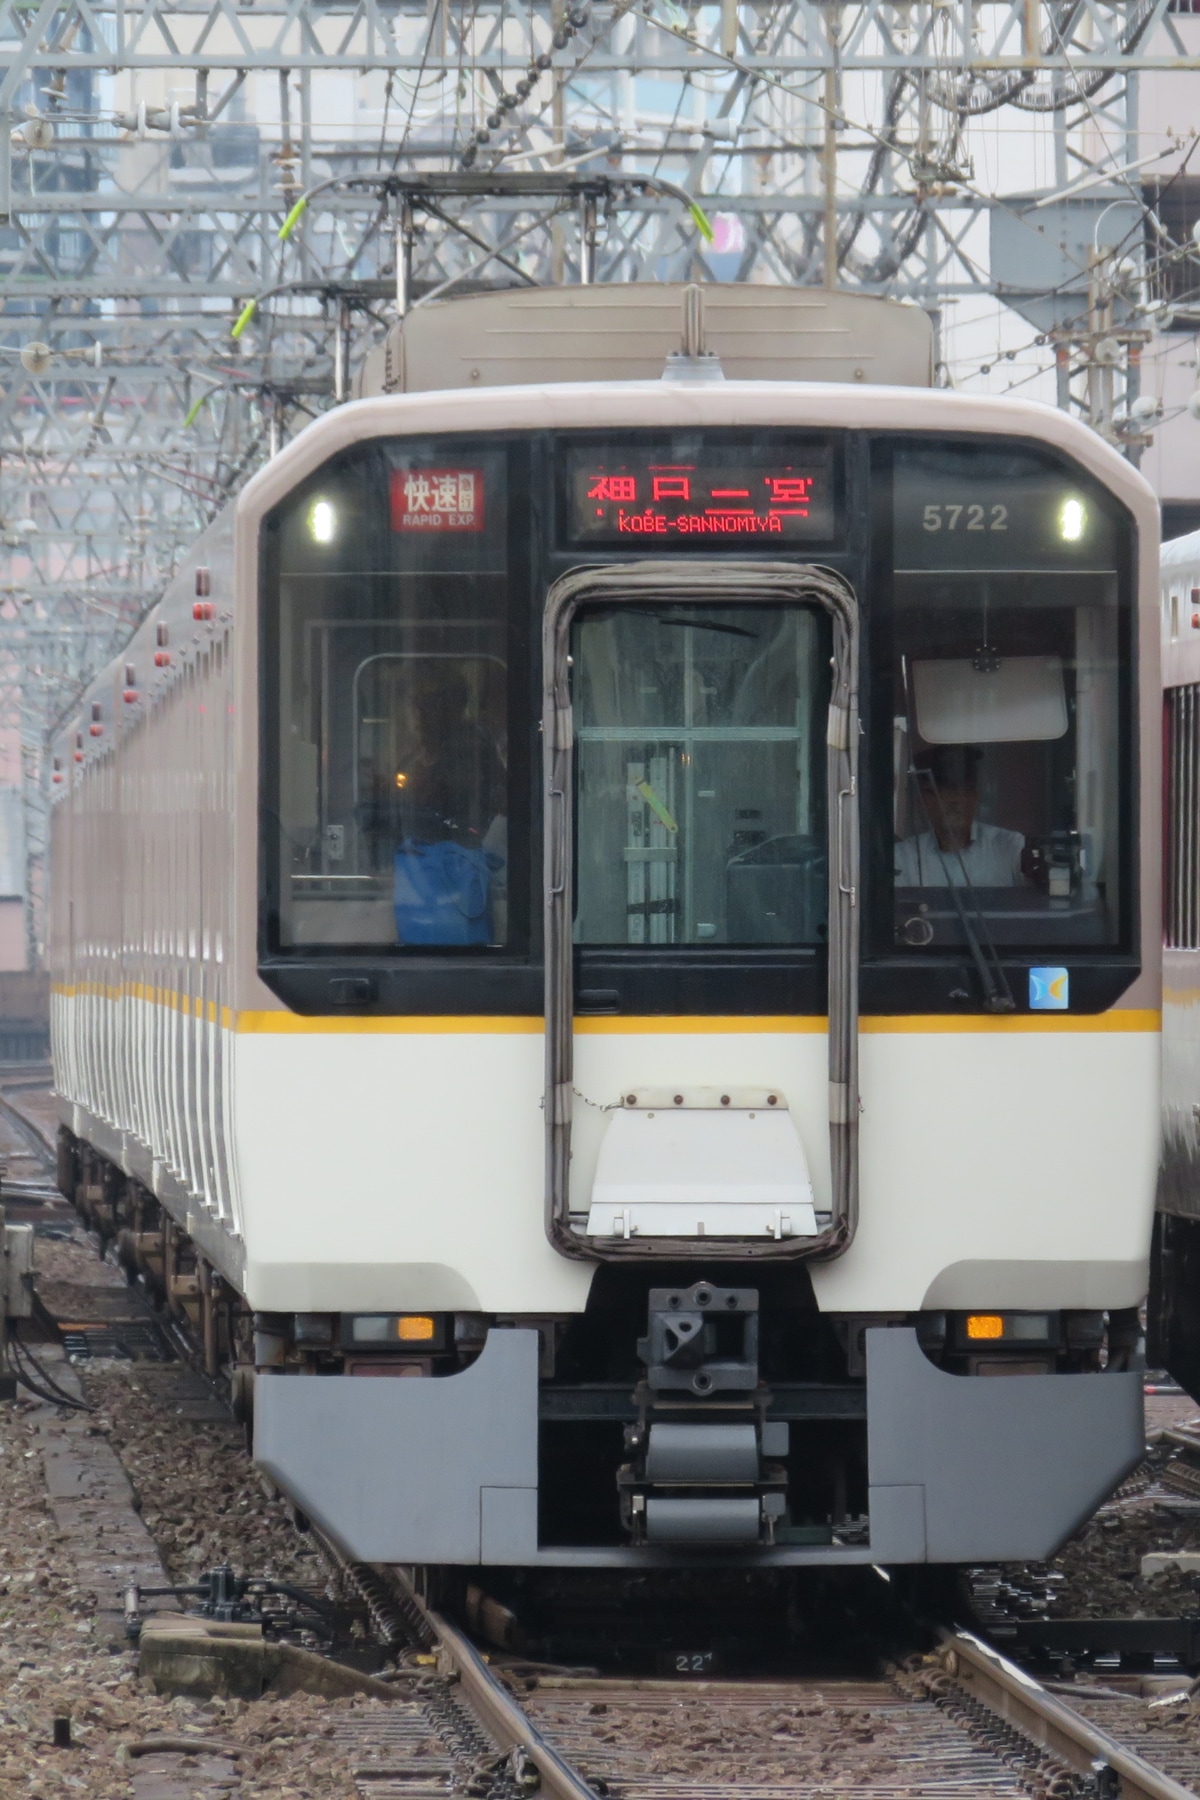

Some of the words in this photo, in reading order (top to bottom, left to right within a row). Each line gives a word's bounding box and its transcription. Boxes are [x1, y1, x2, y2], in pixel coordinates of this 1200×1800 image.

[403, 514, 442, 526] RAPID
[619, 515, 782, 532] KOBE-SANNOMIYA
[922, 504, 1008, 531] 5722
